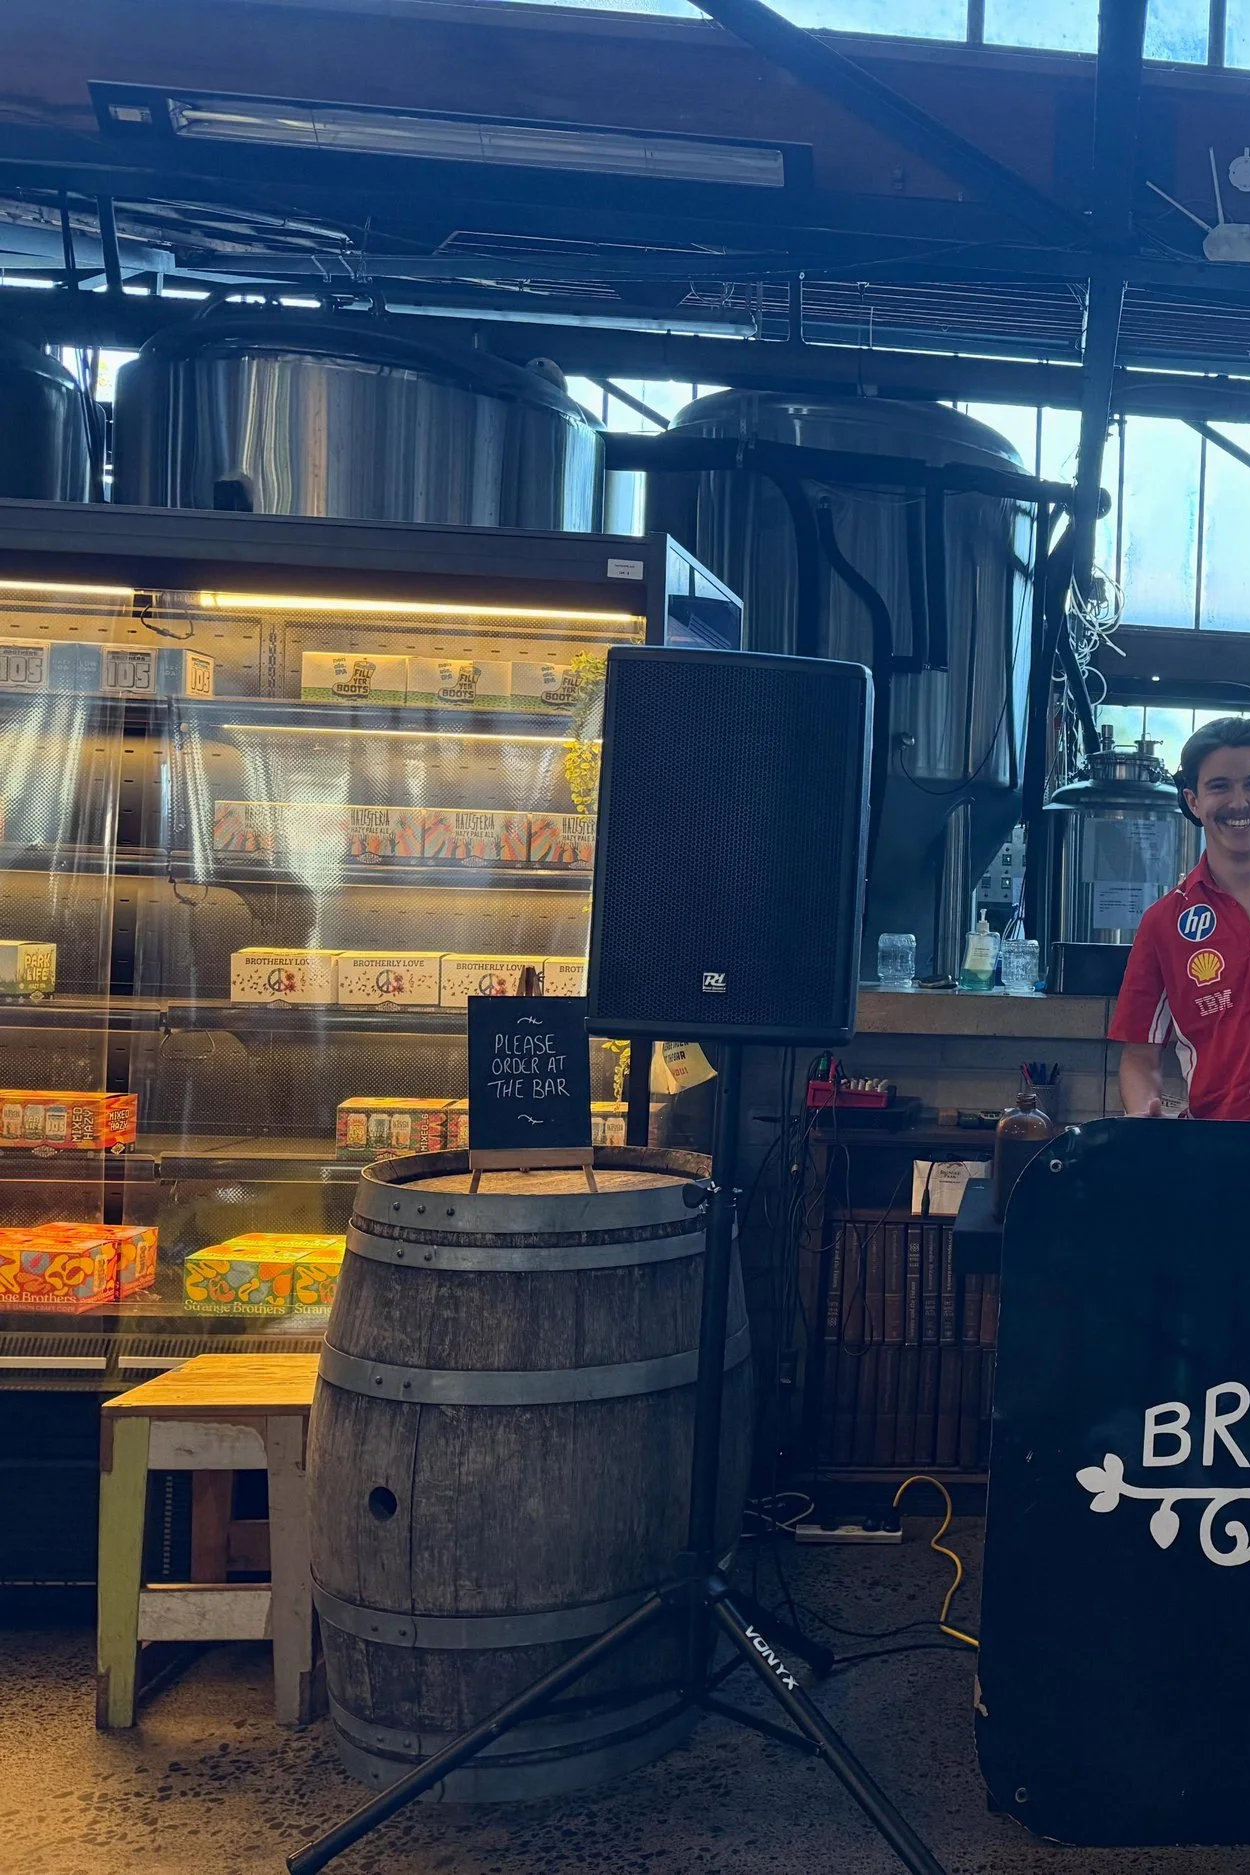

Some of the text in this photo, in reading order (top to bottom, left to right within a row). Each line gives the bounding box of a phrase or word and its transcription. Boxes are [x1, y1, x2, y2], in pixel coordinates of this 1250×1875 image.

[106, 661, 150, 688] 105
[191, 667, 211, 693] 105
[355, 669, 371, 679] FILL
[460, 673, 476, 684] FILL
[336, 684, 369, 694] BOOTS
[442, 689, 475, 699] BOOTS
[1184, 906, 1211, 941] hp
[25, 953, 51, 968] PARK
[245, 958, 294, 966] BROTHERLY
[353, 959, 425, 968] BROTHERLY LOVE
[456, 963, 505, 971] BROTHERLY
[26, 967, 50, 981] LIFE
[1195, 989, 1234, 1017] IBM
[495, 1033, 556, 1055] PLEASE
[491, 1055, 567, 1076] ORDER AT
[488, 1078, 570, 1099] THE BAR
[109, 1110, 129, 1121] MIXED
[72, 1106, 83, 1142] MIXED
[83, 1109, 95, 1140] HAZY
[110, 1121, 128, 1131] HAZY
[22, 1291, 77, 1303] Brothers
[184, 1300, 286, 1315] Strange Brothers
[745, 1625, 799, 1690] VONYX
